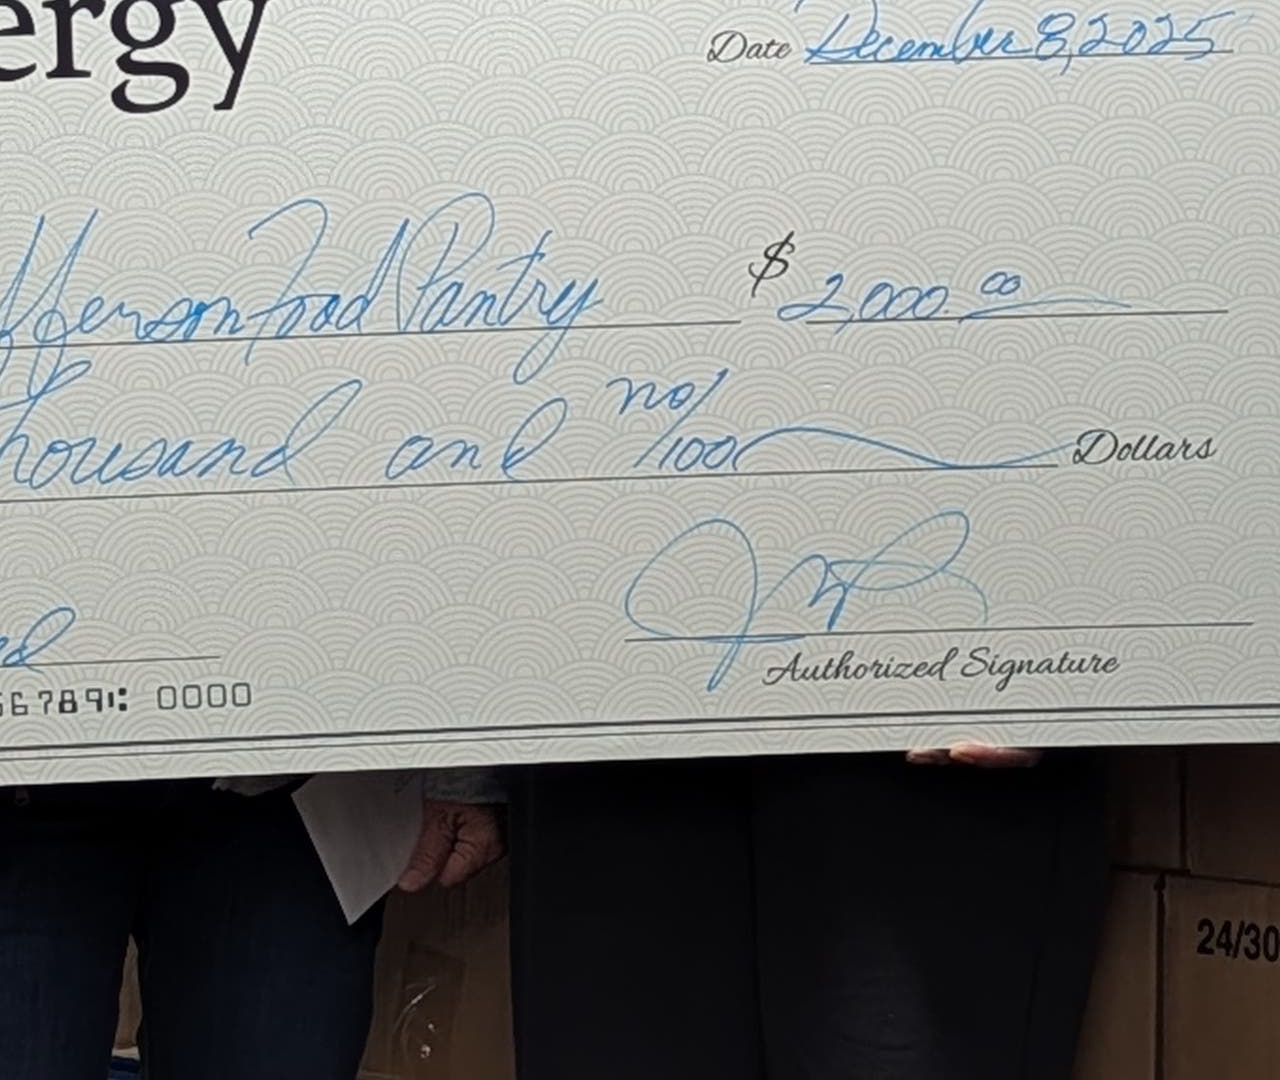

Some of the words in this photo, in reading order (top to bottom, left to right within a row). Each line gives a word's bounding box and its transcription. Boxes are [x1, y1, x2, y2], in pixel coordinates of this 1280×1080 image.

[707, 30, 792, 62] Date
[748, 230, 796, 298] $
[246, 198, 410, 366] Food
[397, 192, 605, 386] Pantry
[385, 396, 570, 482] and
[1071, 428, 1219, 466] Dollars
[762, 647, 959, 686] Authorized
[960, 646, 1121, 691] Signature
[156, 681, 253, 711] 0000
